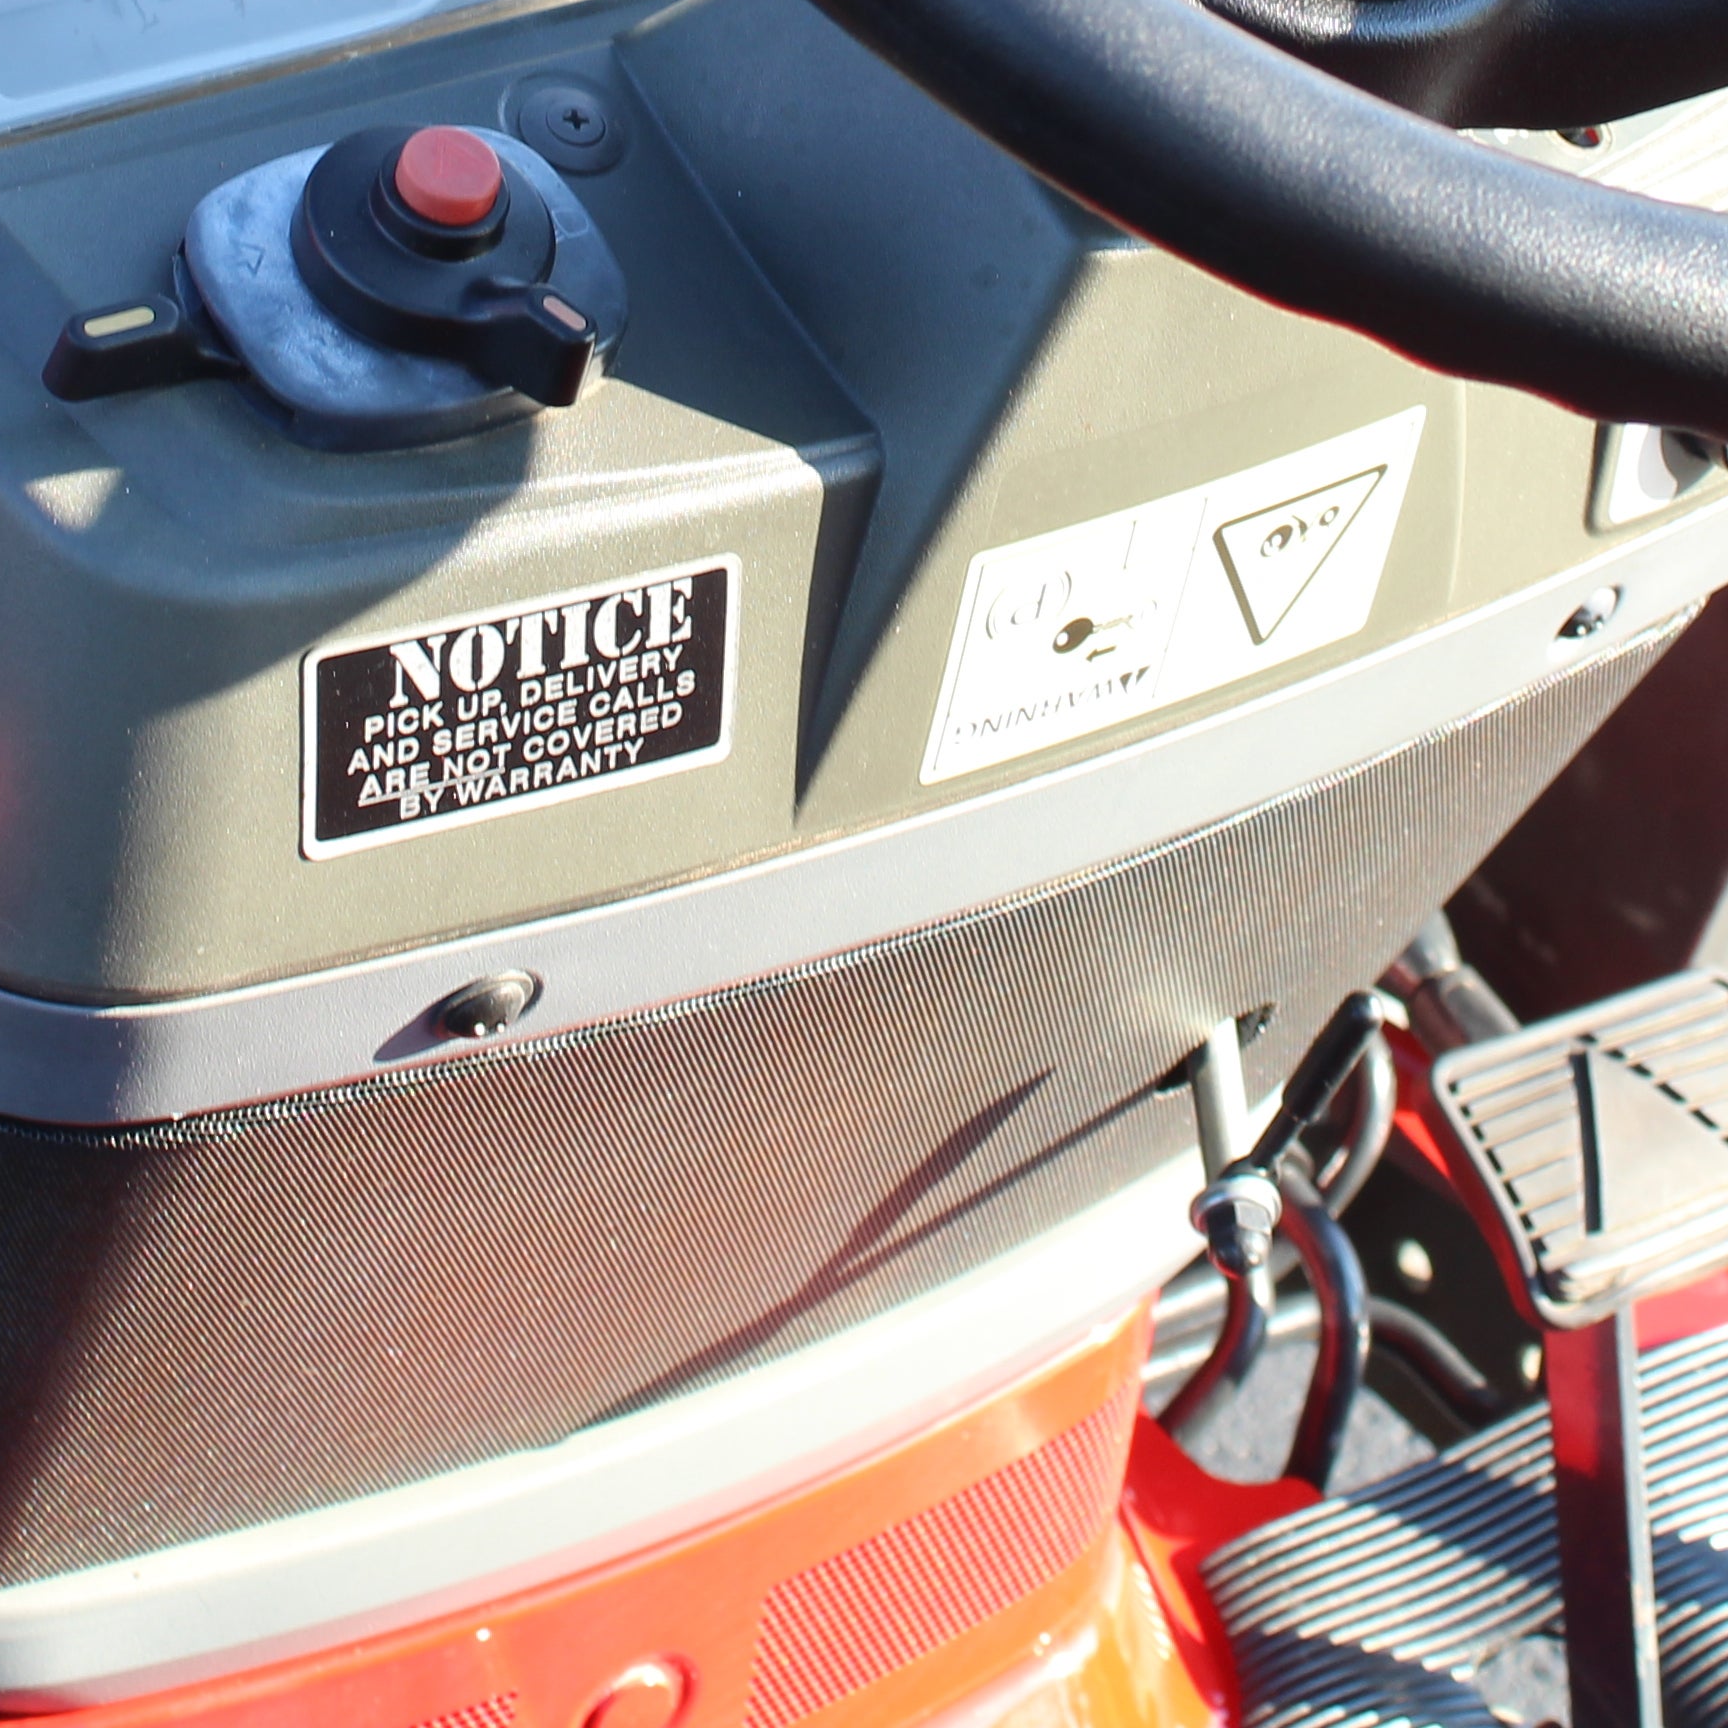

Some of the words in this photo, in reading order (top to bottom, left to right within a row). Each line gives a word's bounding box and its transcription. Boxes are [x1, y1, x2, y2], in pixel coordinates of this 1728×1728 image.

[389, 577, 693, 708] NOTICE
[347, 734, 428, 776] AND
[432, 699, 578, 756] SERVICE
[589, 670, 696, 717] CALLS
[364, 697, 444, 744] PICK
[521, 644, 683, 708] DELIVERY
[359, 764, 430, 803] ARE
[443, 744, 511, 782] NOT
[523, 701, 683, 762] COVERED
[400, 787, 442, 821] BY
[455, 739, 645, 807] WARRANTY
